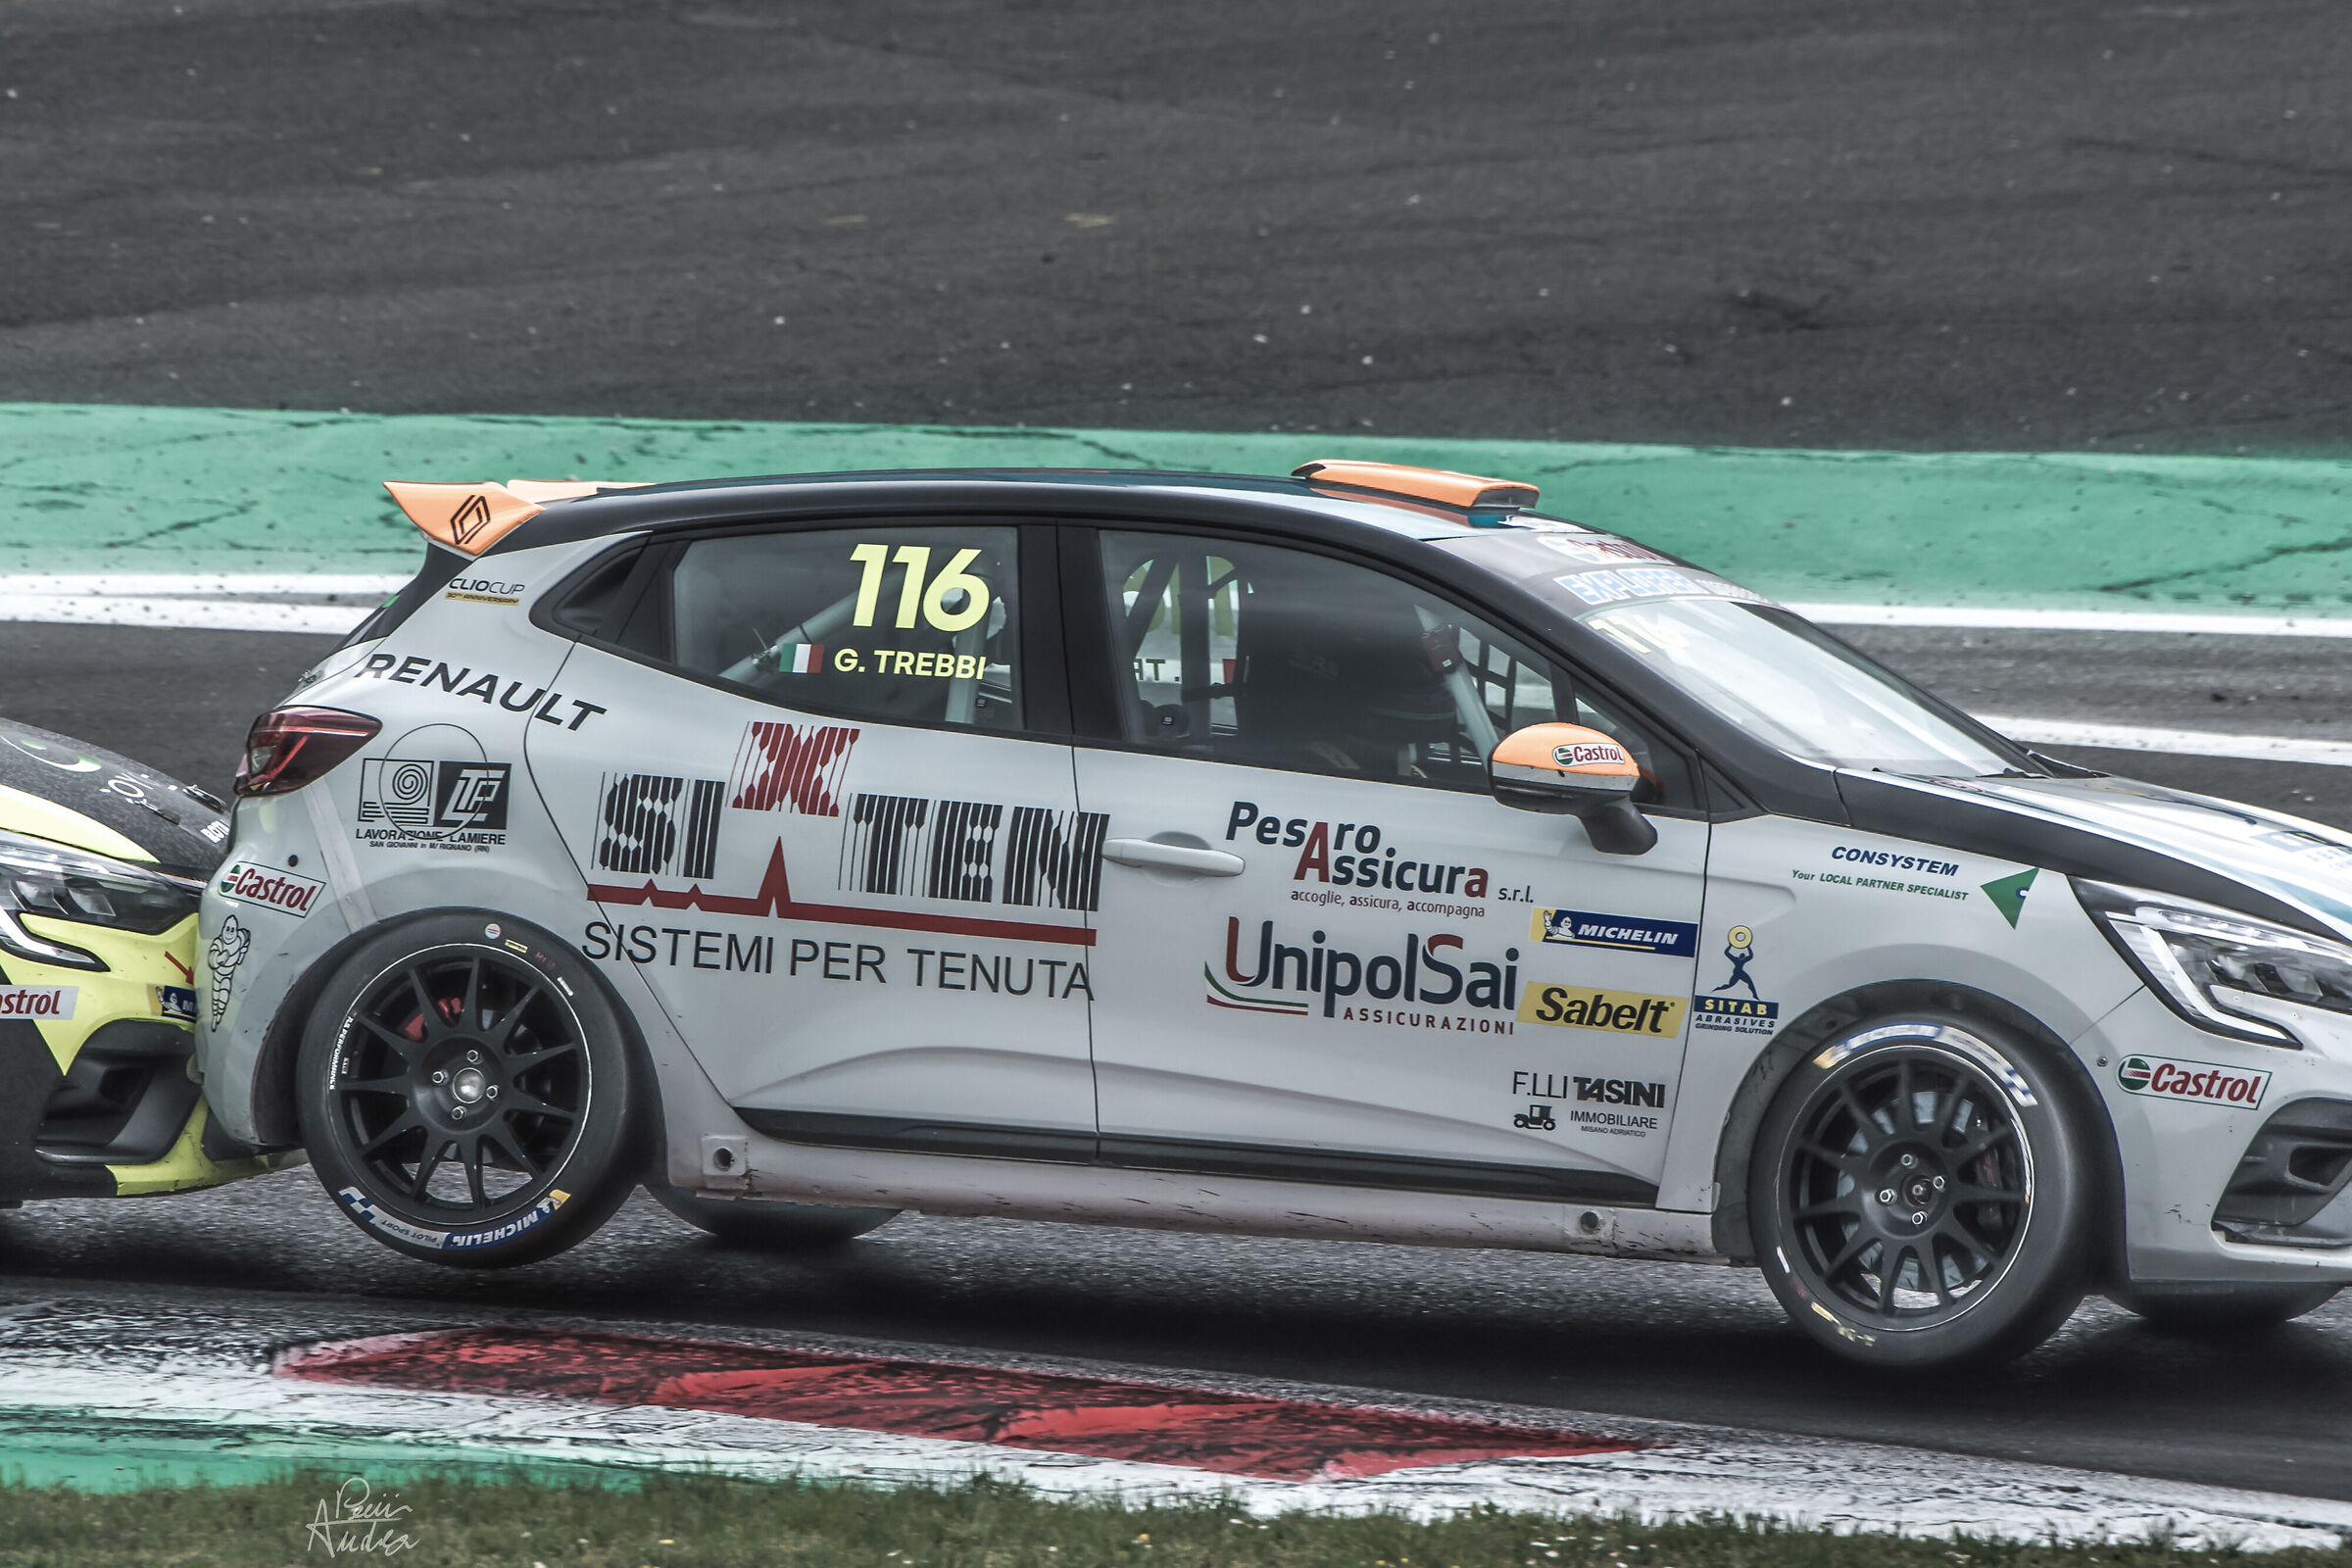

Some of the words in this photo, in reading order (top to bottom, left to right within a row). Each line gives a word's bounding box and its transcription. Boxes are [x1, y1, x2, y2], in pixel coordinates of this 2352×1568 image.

[849, 542, 990, 632] 116
[834, 648, 864, 674] G.
[874, 649, 986, 680] TREBBI
[354, 654, 608, 731] RENAULT
[1573, 746, 1624, 762] Castrol
[449, 832, 507, 845] LAMIERE
[1294, 821, 1490, 899] Assicura
[1497, 886, 1535, 904] s.r.l.
[1831, 846, 1960, 877] CONSYSTEM
[236, 867, 317, 912] Castrol
[1791, 869, 1815, 881] Your
[1819, 872, 1853, 886] LOCAL
[1855, 877, 1904, 891] PARTNER
[1907, 884, 1969, 902] SPECIALIST
[1291, 890, 1345, 906] accoglie,
[1349, 894, 1402, 912] assicura,
[1406, 900, 1486, 919] accompagna
[1577, 923, 1678, 946] MICHELIN
[581, 921, 774, 974] SISTEMI
[790, 938, 887, 984] PER
[907, 948, 1095, 1002] TENUTA
[1225, 916, 1519, 1018] UnipolSai
[0, 990, 62, 1015] strol
[1536, 987, 1669, 1034] Sabelt
[1705, 999, 1768, 1015] SITAB
[1344, 1006, 1514, 1036] ASSICURAZIONI
[1695, 1014, 1775, 1028] ABRASIVES
[1695, 1022, 1733, 1032] GRINDING
[1735, 1026, 1774, 1036] SOLUTION
[1513, 1070, 1568, 1100] F.LLI
[1573, 1076, 1666, 1108] TASINI
[2151, 1063, 2262, 1104] Castrol
[1570, 1109, 1658, 1129] IMMOBILIARE
[1581, 1125, 1609, 1134] MISANO
[1609, 1128, 1646, 1138] ADRIATICO
[380, 1219, 411, 1236] SPORT
[409, 1230, 438, 1243] PILOT
[451, 1209, 538, 1248] MICHELIN
